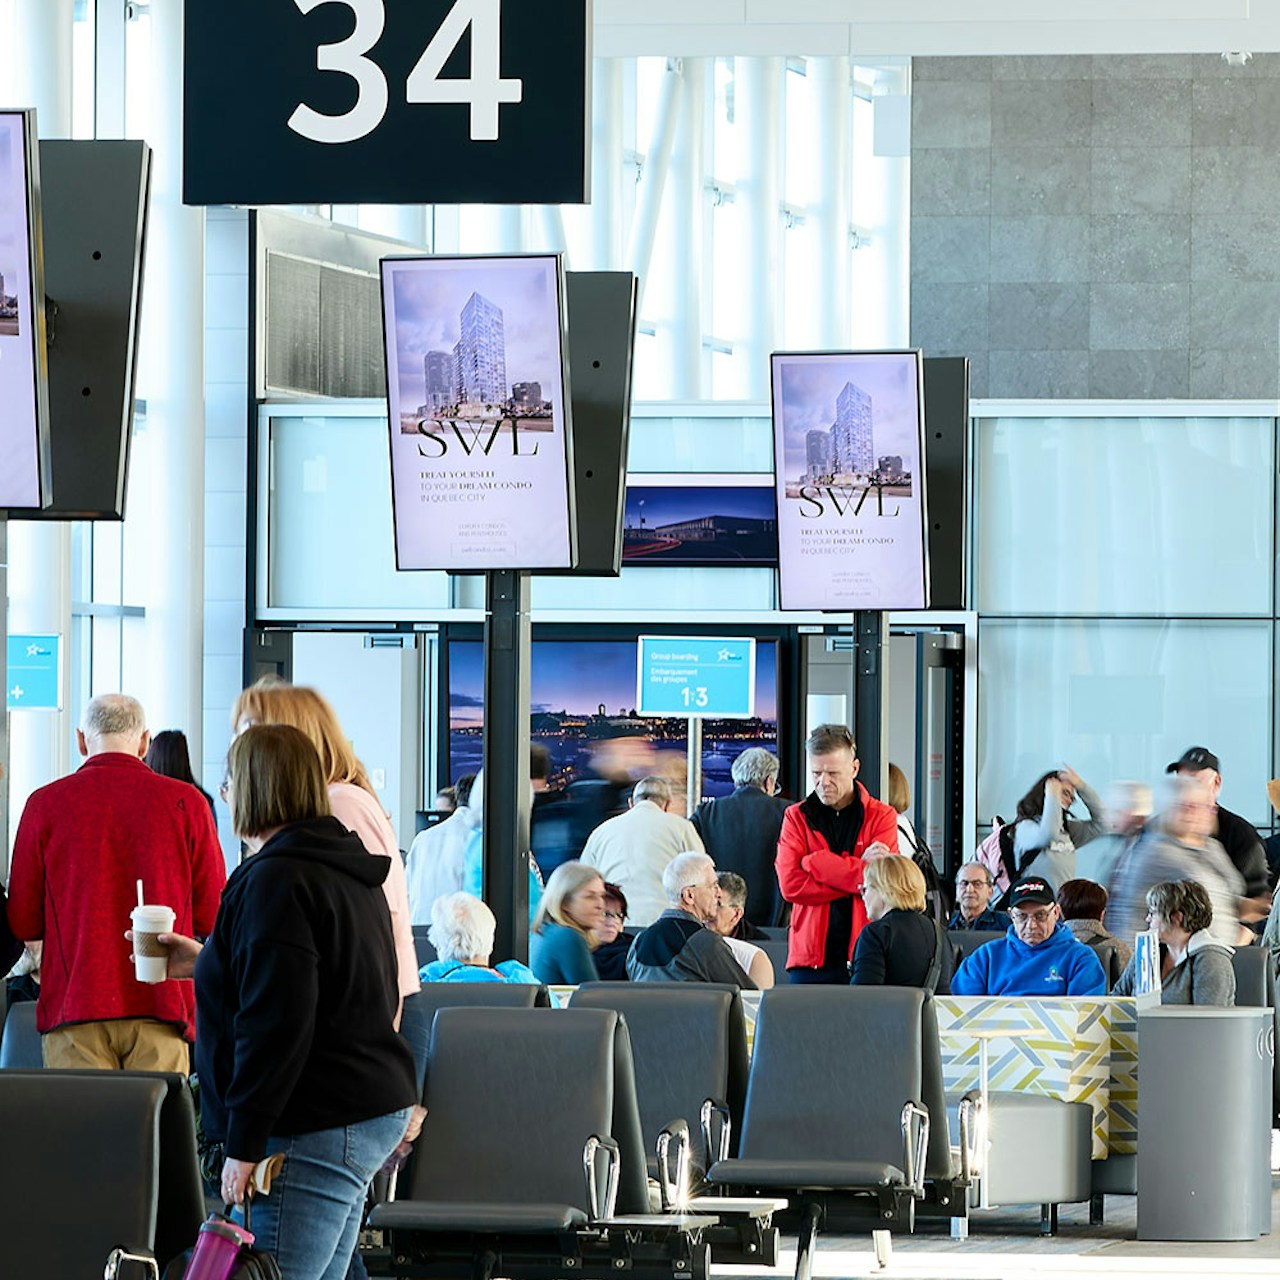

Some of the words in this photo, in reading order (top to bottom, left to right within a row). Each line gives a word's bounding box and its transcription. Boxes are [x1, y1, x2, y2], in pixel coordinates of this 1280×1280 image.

[287, 0, 523, 143] 34
[417, 419, 539, 458] SWL
[799, 486, 900, 518] SWL
